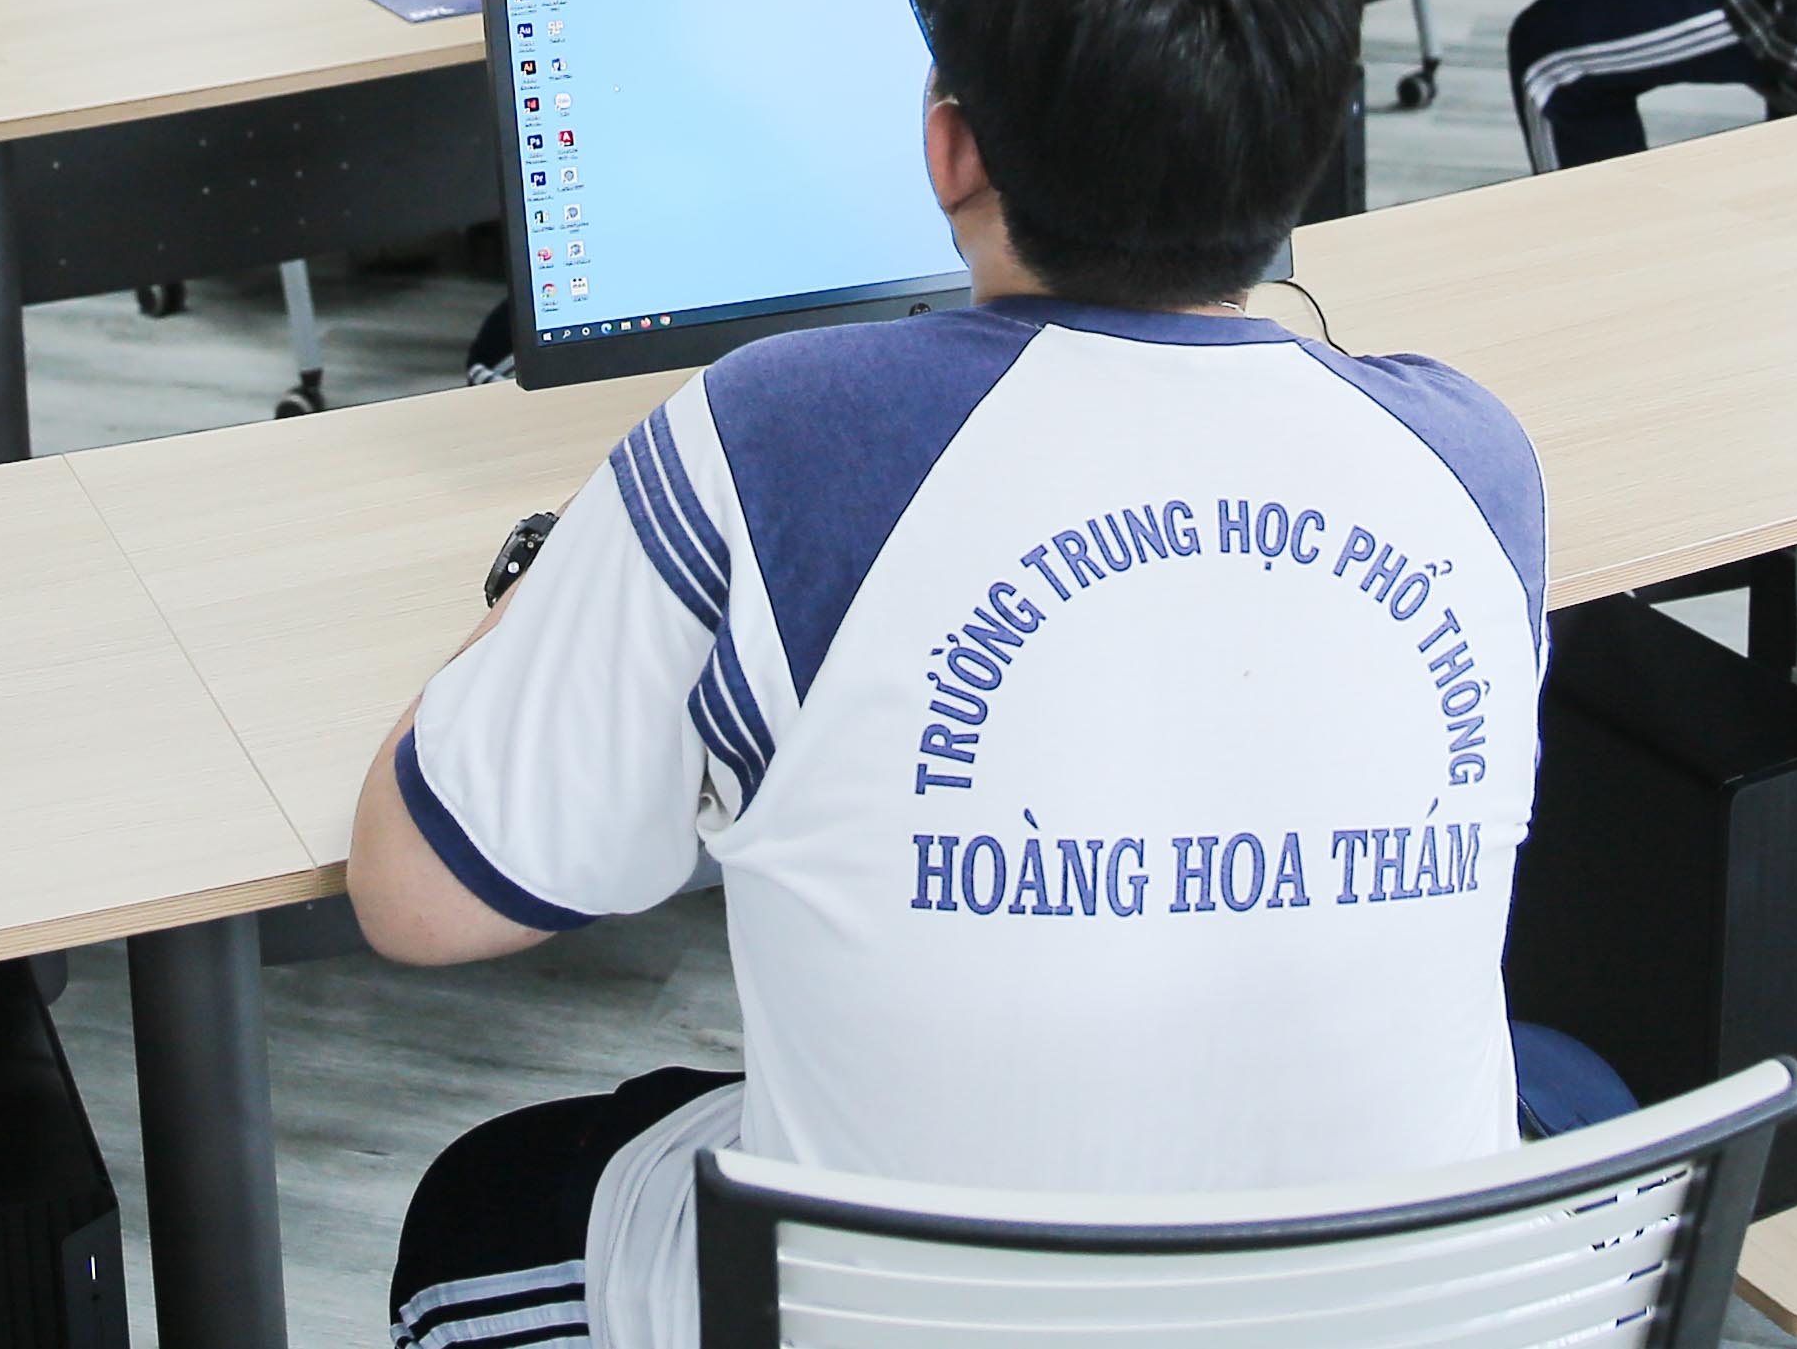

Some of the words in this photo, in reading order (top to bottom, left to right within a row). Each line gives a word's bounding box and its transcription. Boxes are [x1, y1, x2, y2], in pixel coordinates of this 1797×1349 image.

[915, 581, 1048, 796] TRƯỜNG
[1021, 499, 1202, 602] TRUNG
[1218, 498, 1325, 571] HỌC
[1332, 524, 1454, 622] PHỔ
[1417, 608, 1493, 788] THÔNG
[911, 808, 1149, 918] HOÀNG
[1168, 832, 1312, 914] HOA
[1331, 797, 1482, 906] THÁM
